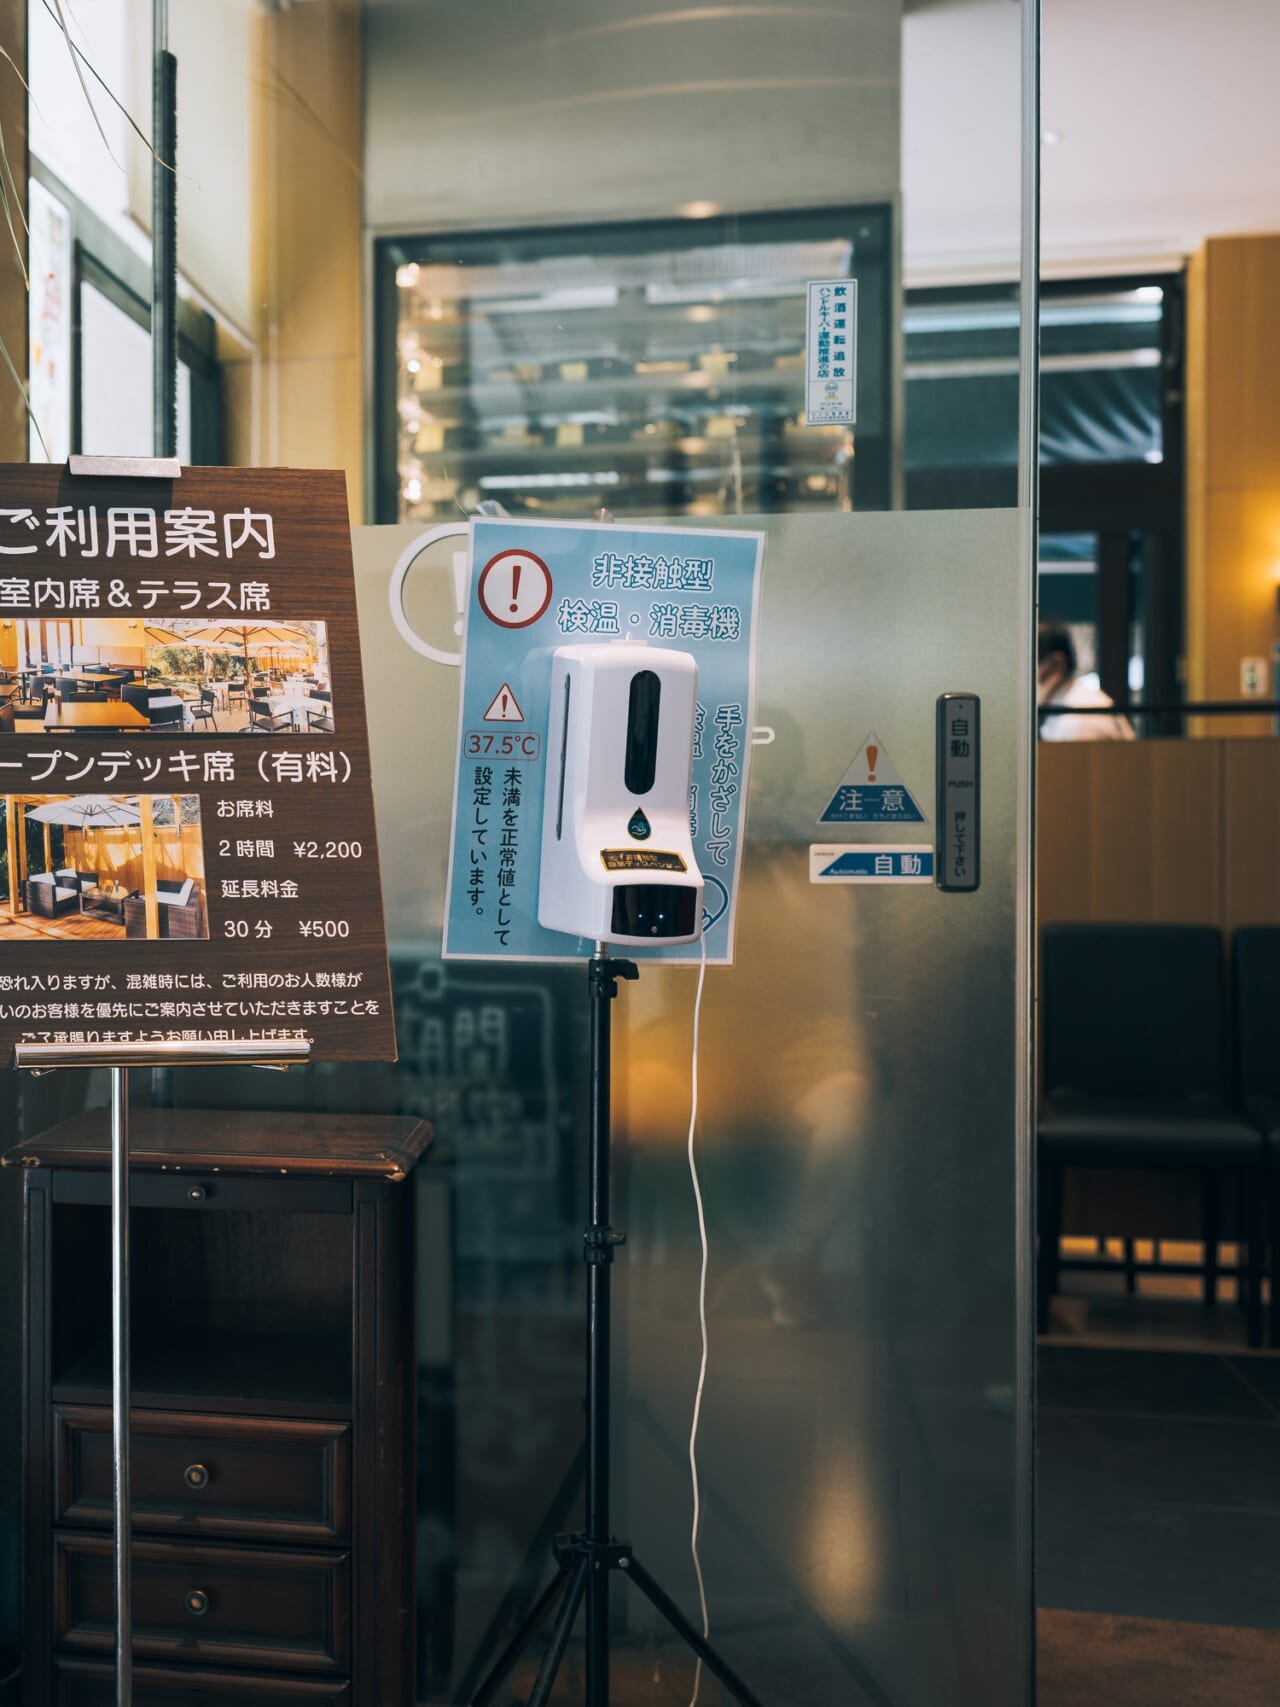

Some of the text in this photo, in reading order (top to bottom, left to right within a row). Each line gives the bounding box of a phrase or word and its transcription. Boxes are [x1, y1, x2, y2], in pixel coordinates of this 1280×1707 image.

[592, 553, 715, 593] 非接触型
[0, 577, 270, 611] 室内席＆テラス席
[557, 598, 741, 640] 検温・消毒機
[951, 718, 970, 758] 自動
[706, 703, 742, 868] 手をかざして
[839, 788, 904, 811] 注意
[217, 800, 273, 818] お席料
[293, 841, 362, 859] ¥2,200
[467, 767, 493, 916] 設定しています。
[494, 767, 522, 946] 未満を正常値として
[875, 855, 921, 875] 自動
[829, 867, 868, 875] Automatic
[221, 880, 299, 898] 延長料金
[299, 920, 349, 938] ¥500
